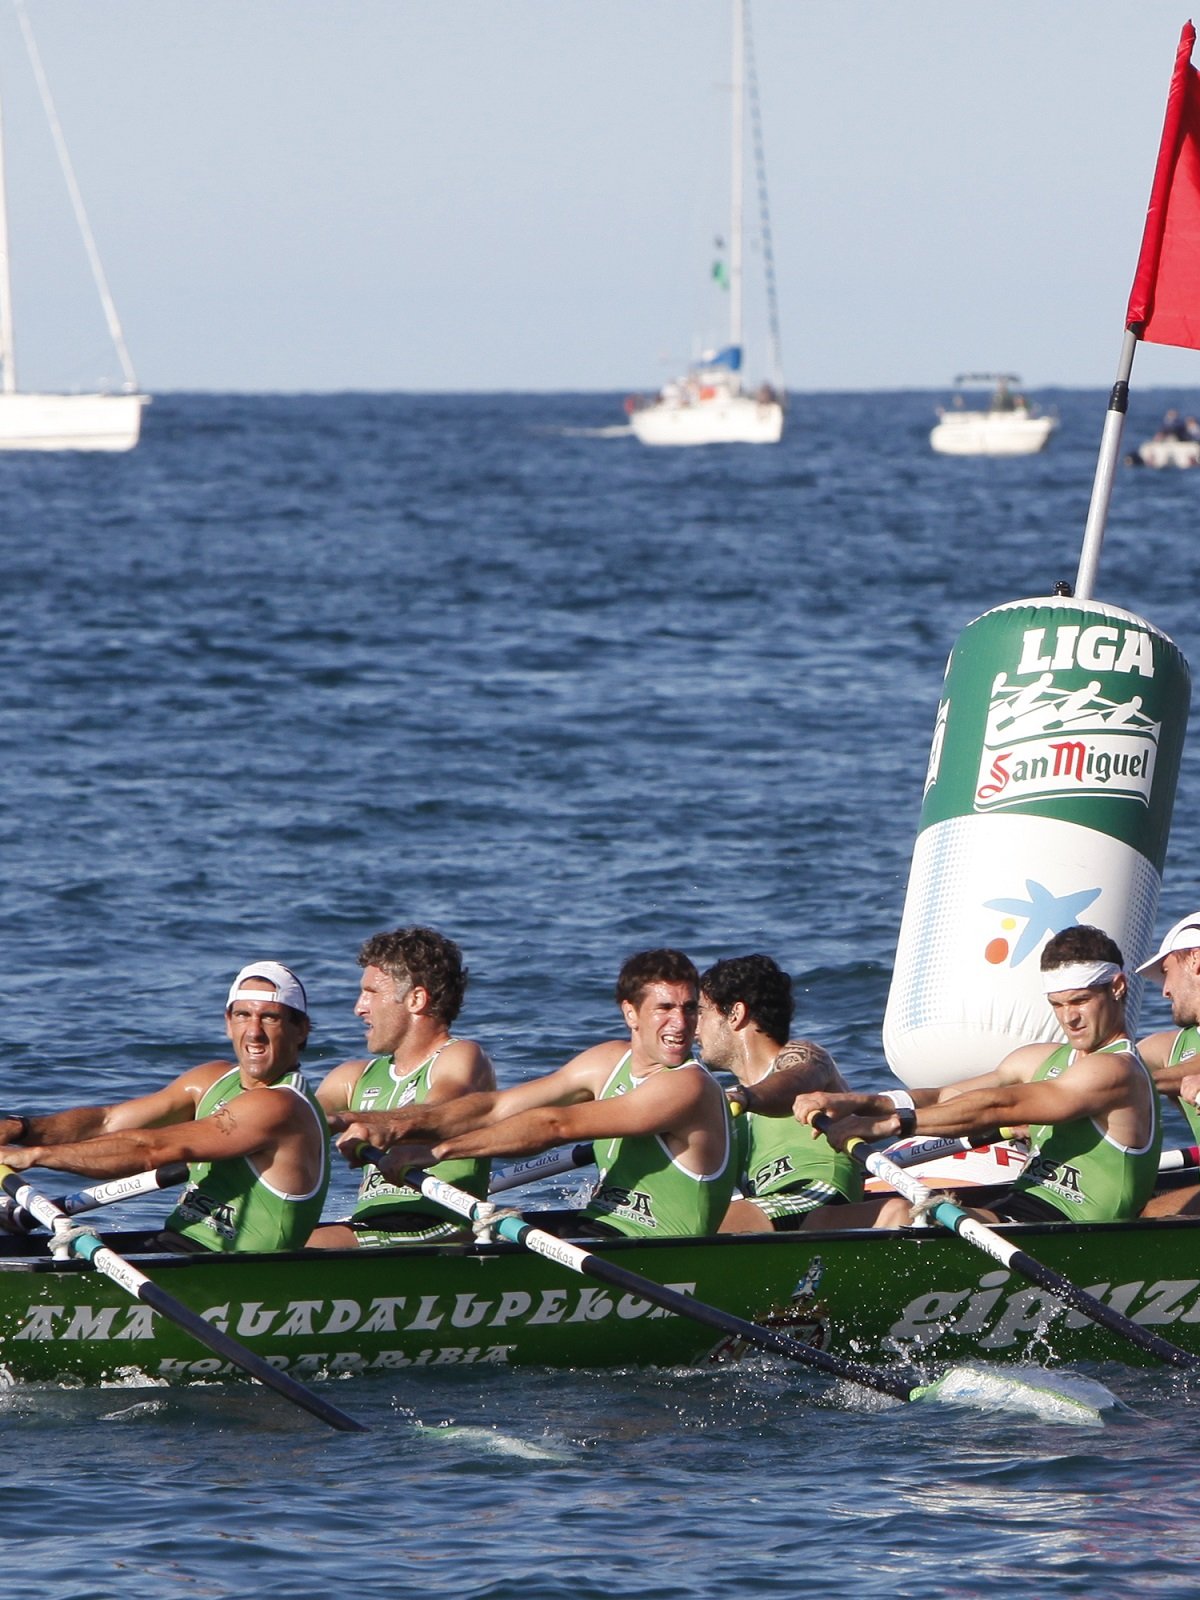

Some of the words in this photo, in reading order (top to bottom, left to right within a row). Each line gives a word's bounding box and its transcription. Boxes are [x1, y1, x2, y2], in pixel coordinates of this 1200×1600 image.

[1017, 625, 1155, 678] LIGA
[1027, 1156, 1081, 1192] RSA
[14, 1304, 163, 1341] AMA
[199, 1282, 697, 1337] GUADALUPEKOA
